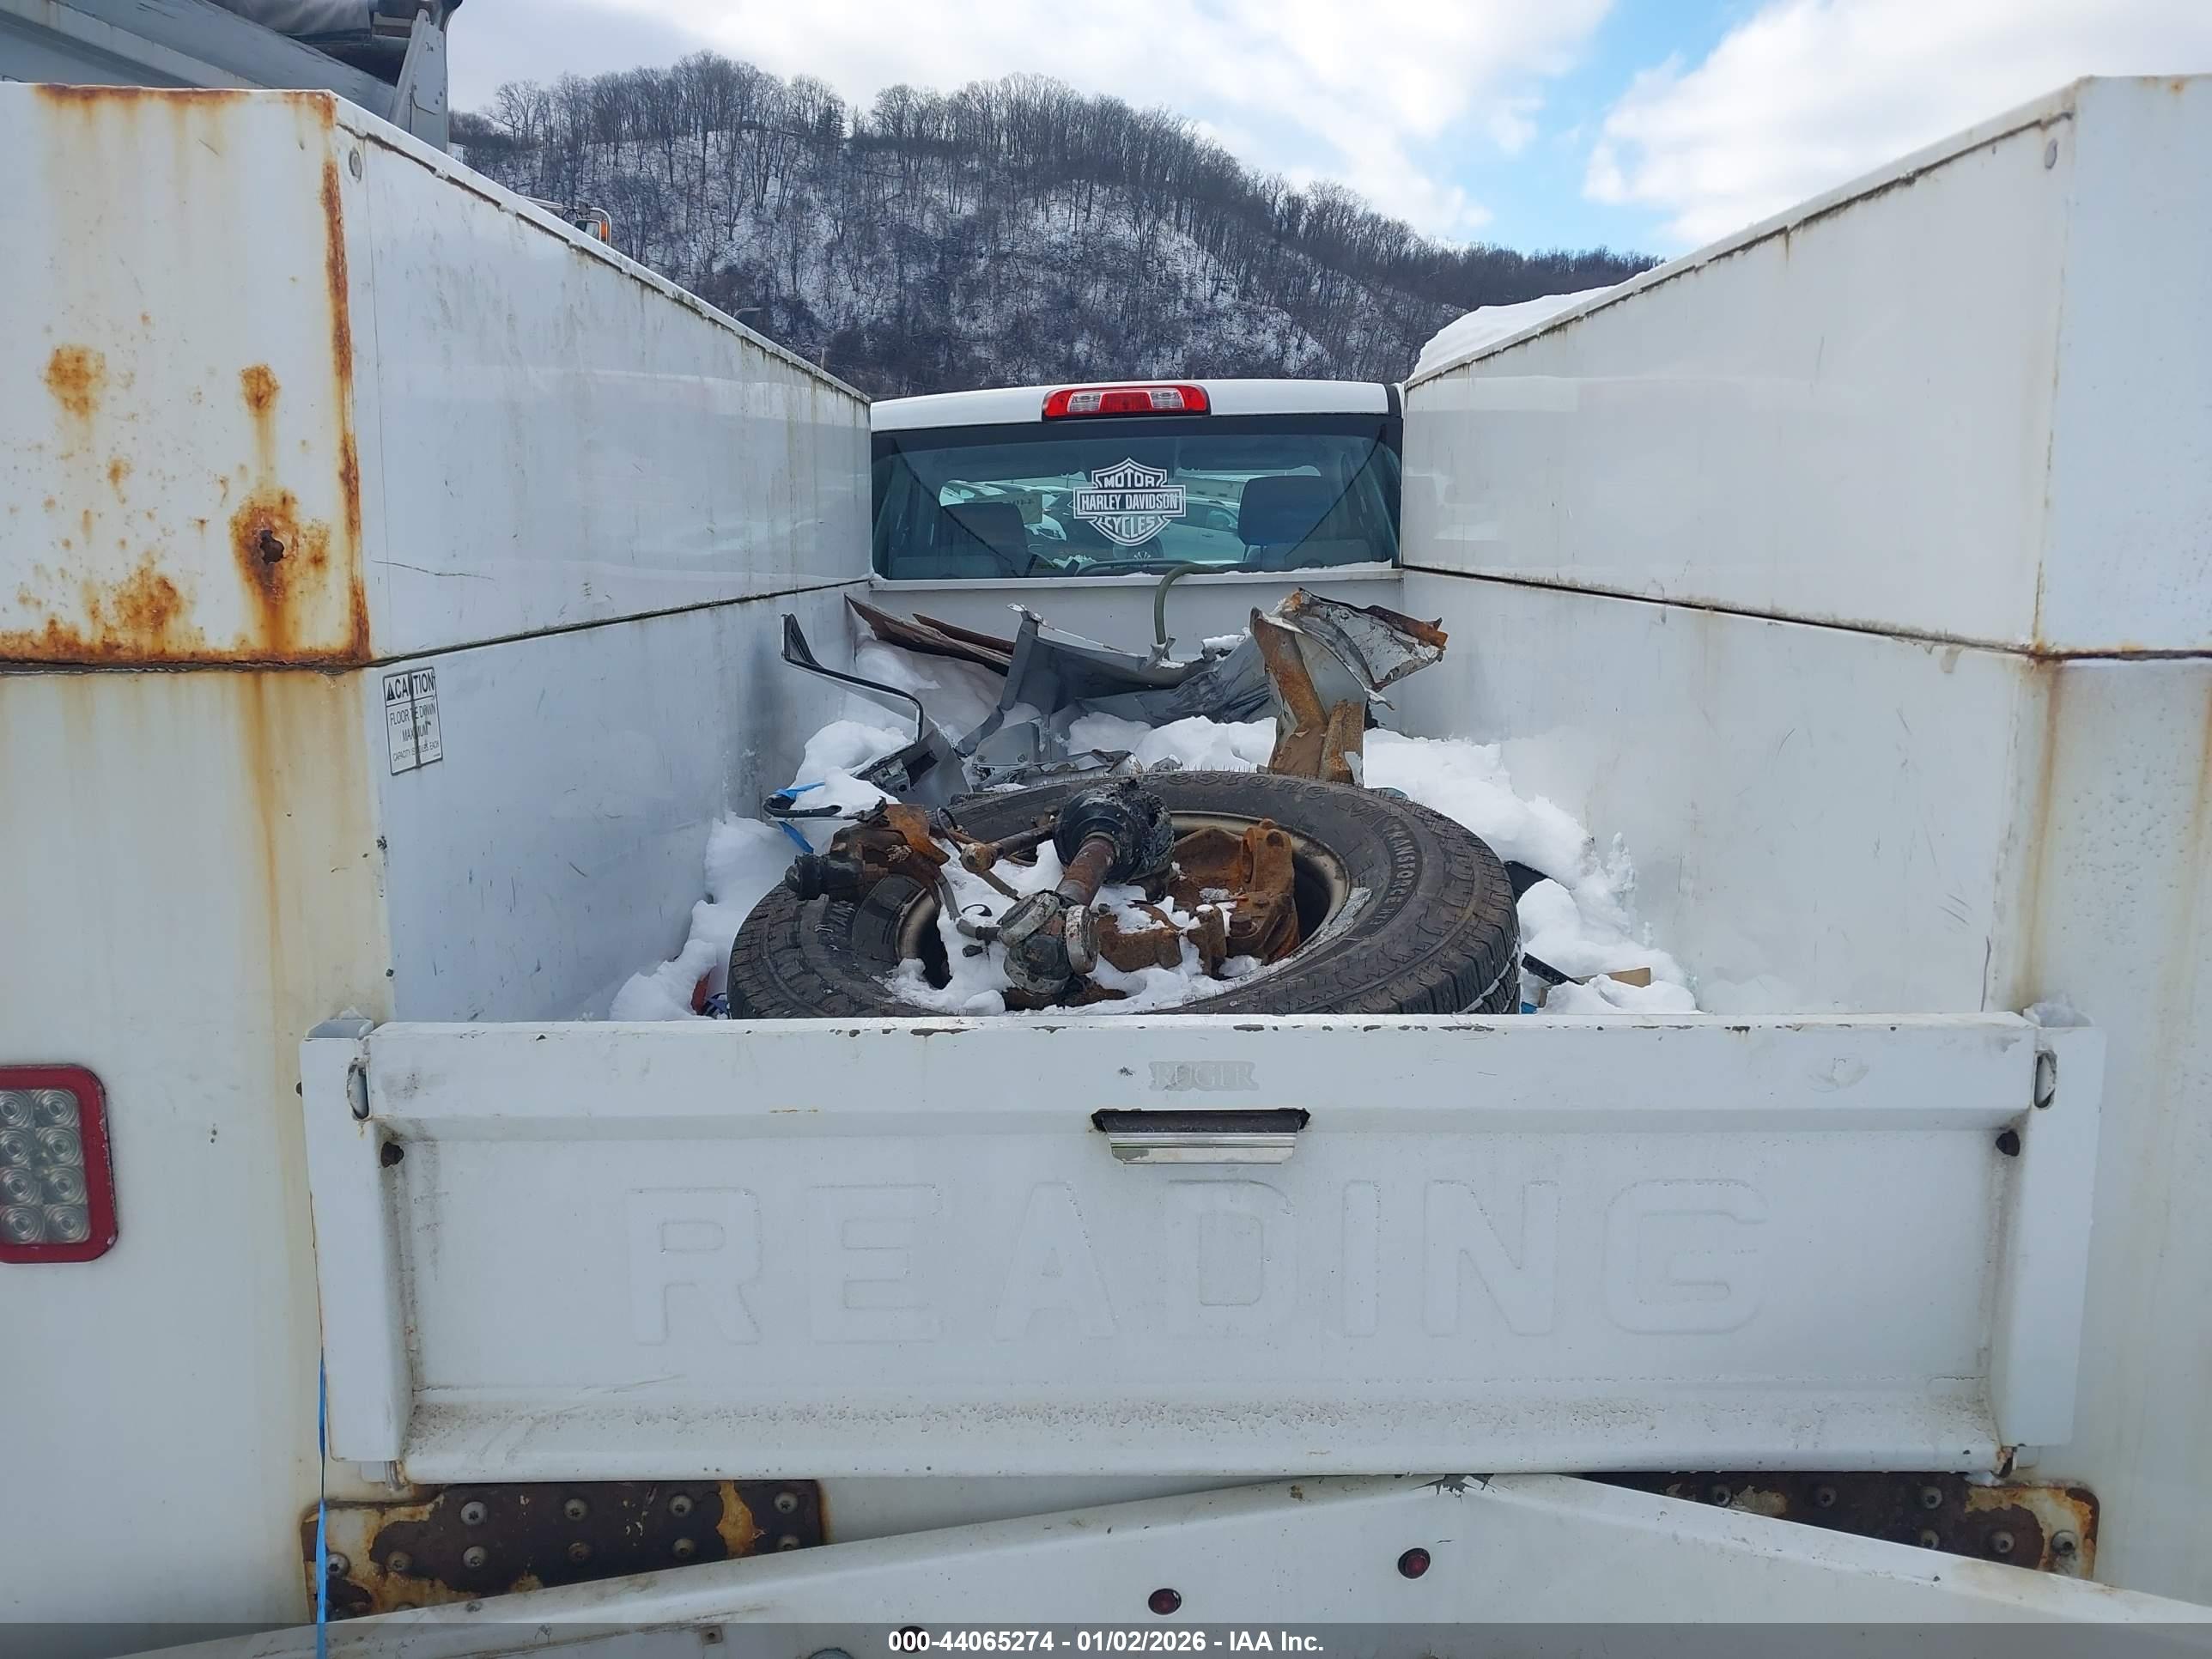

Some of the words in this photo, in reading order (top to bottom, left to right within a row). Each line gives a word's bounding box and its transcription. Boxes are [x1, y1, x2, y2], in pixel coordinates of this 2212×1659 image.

[1103, 467, 1155, 488] MOTOR
[1081, 494, 1121, 511] HARLEY
[1126, 492, 1178, 510] DAVIDSON
[1105, 516, 1155, 539] CYCLES
[394, 672, 434, 700] CATION
[1384, 822, 1416, 903] TRANSFORCE
[624, 1178, 1768, 1346] READING
